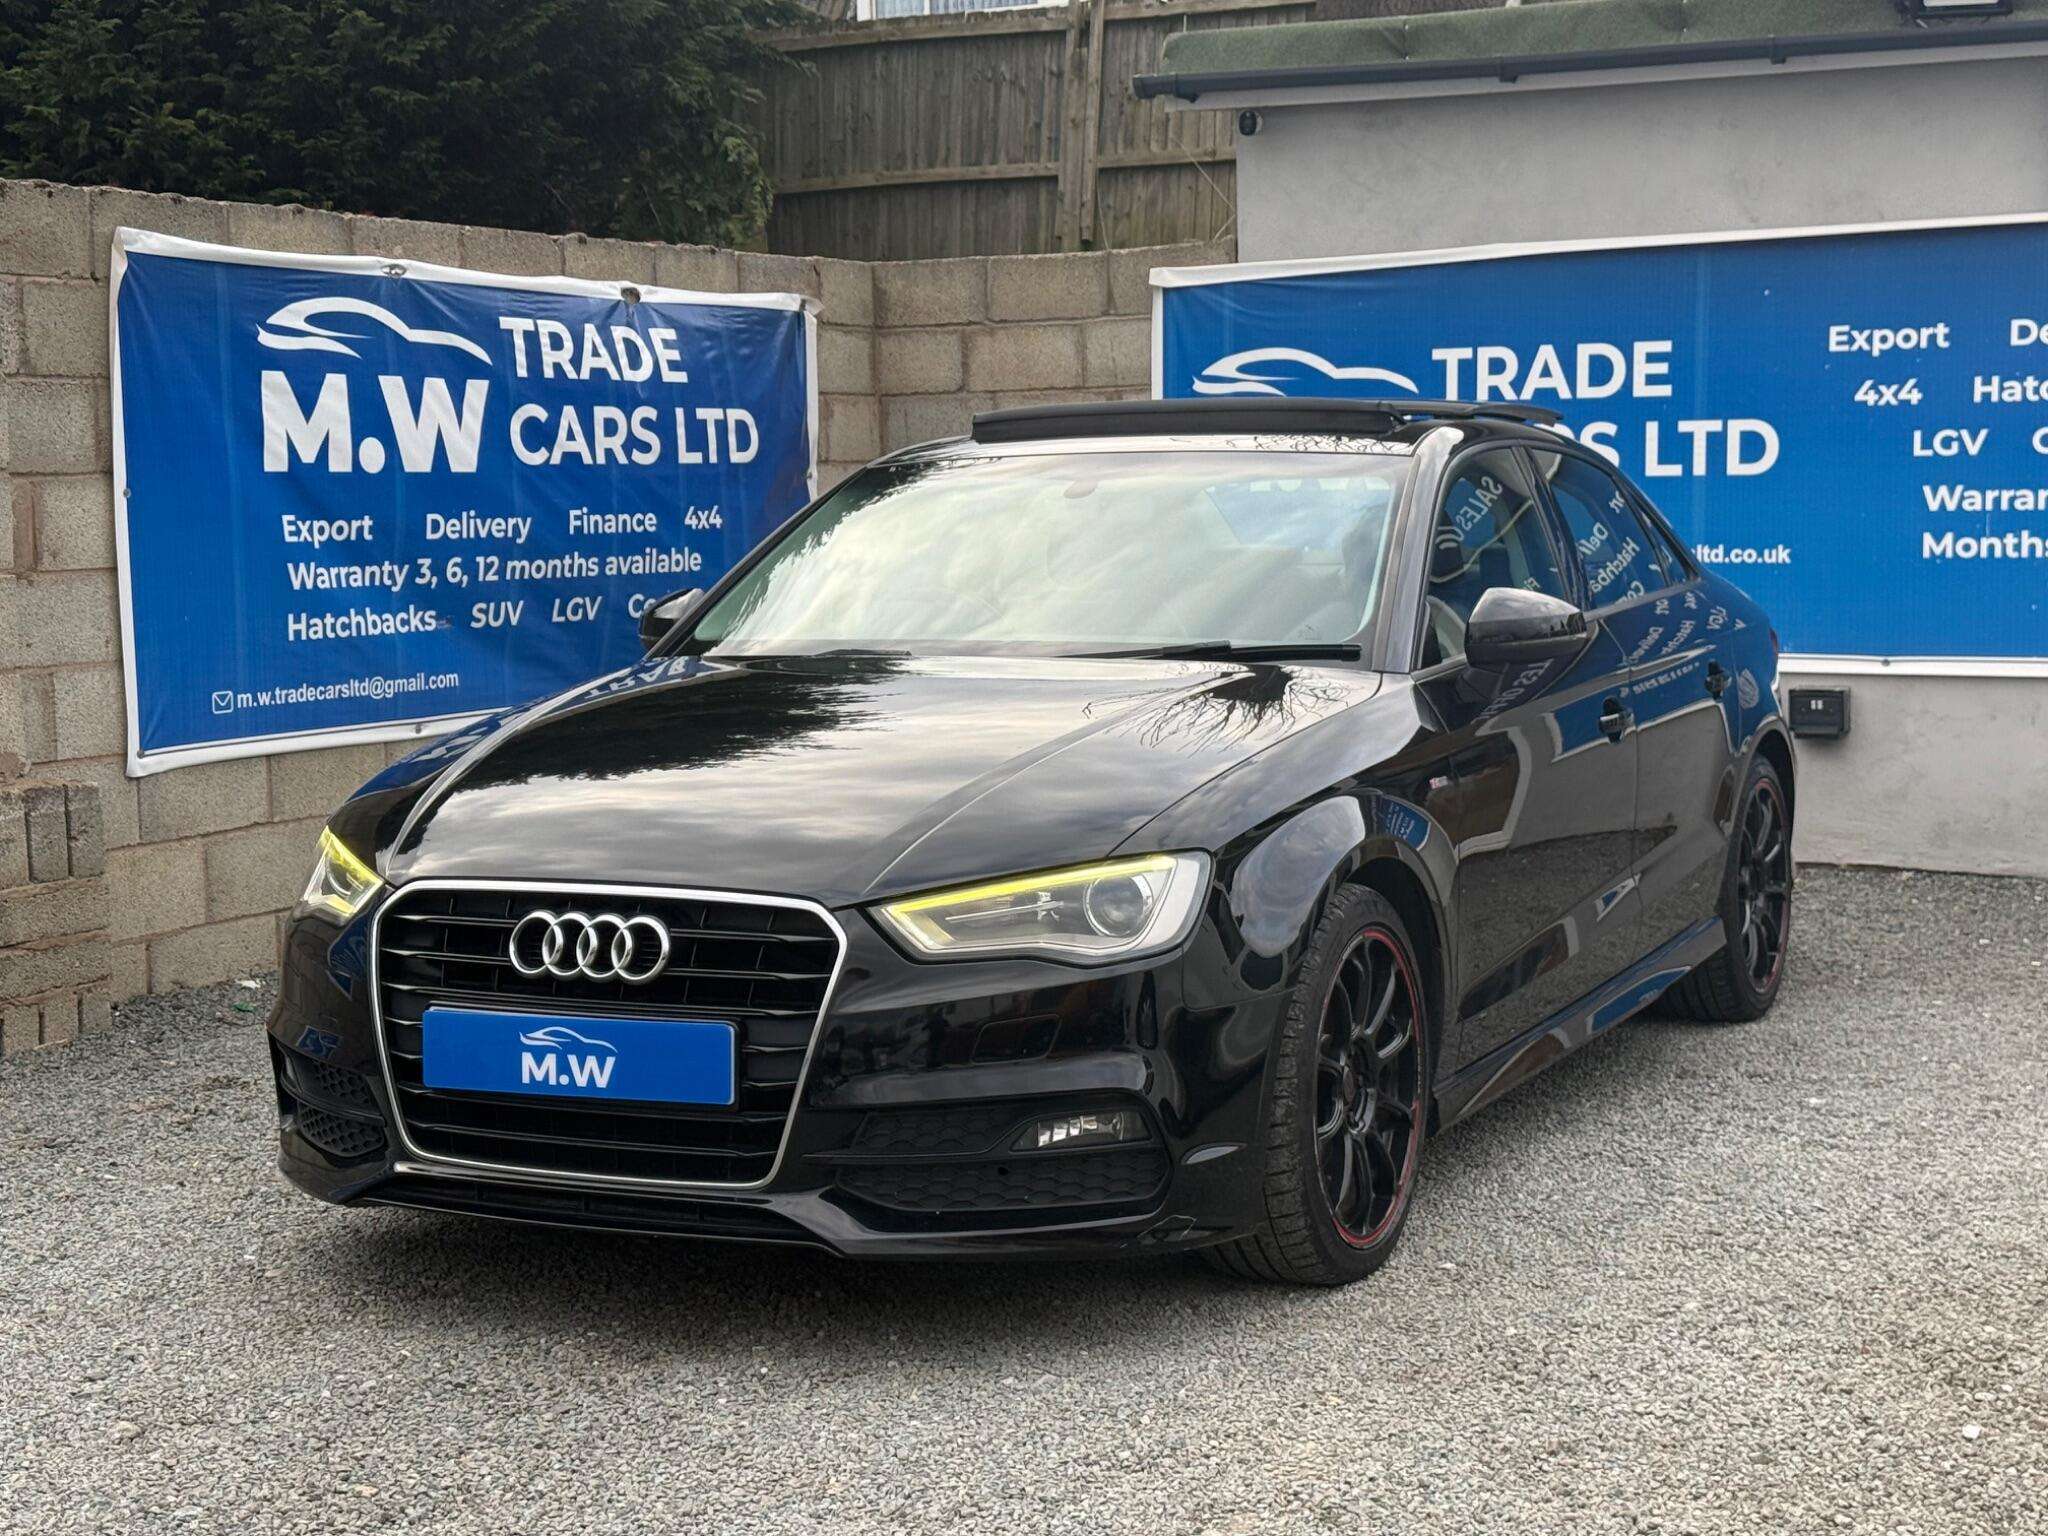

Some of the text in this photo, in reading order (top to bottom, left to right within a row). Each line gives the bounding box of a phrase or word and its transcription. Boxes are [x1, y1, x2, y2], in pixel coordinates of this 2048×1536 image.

[499, 316, 688, 382] TRADE
[1829, 323, 1950, 356] Export
[1432, 341, 1673, 403] TRADE
[1855, 379, 1922, 406] 4x4
[261, 371, 489, 473] M.W
[510, 404, 758, 465] CARS LTD
[1914, 429, 1988, 456] LGV
[1645, 419, 1779, 476] LTD
[282, 506, 722, 549] Export Delivery Finance 4x4
[1923, 530, 2048, 558] Month
[288, 548, 701, 591] Warranty 3, 6, 12 months available
[289, 605, 436, 640] Hatchbacks
[471, 601, 523, 627] SUV
[553, 597, 601, 622] LGV
[238, 673, 459, 708] m.w.tradecarsltd@gmail.com
[522, 1052, 615, 1088] M.W
